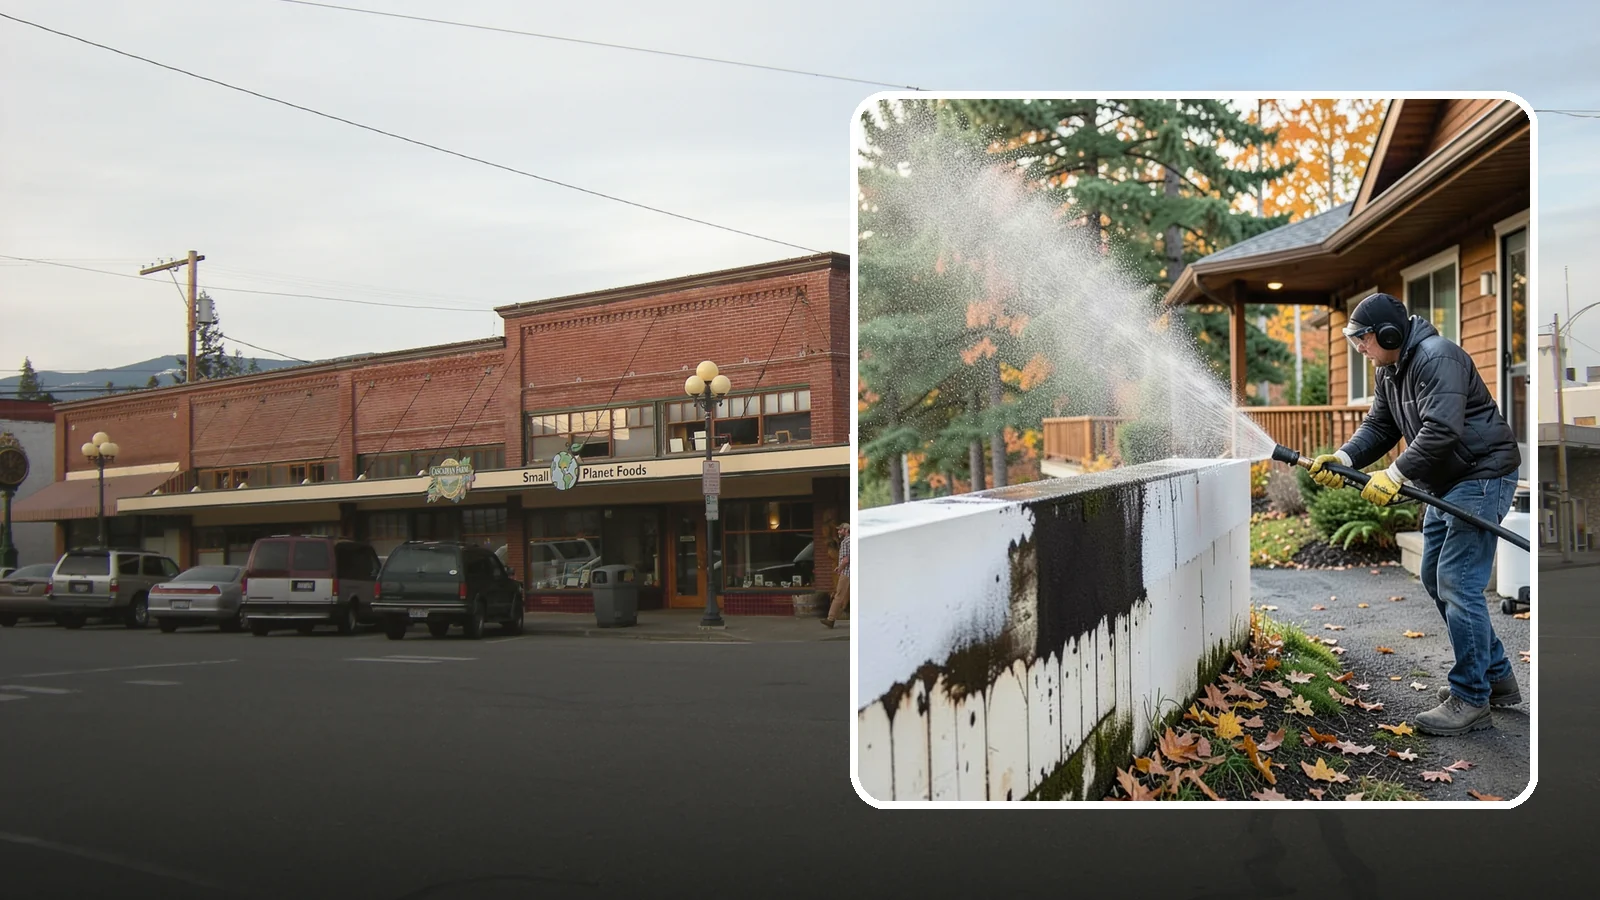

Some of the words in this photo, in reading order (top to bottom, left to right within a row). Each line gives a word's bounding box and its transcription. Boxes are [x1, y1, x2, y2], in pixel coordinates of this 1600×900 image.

[523, 471, 549, 483] Small
[582, 467, 614, 479] Planet
[617, 464, 647, 477] Foods
